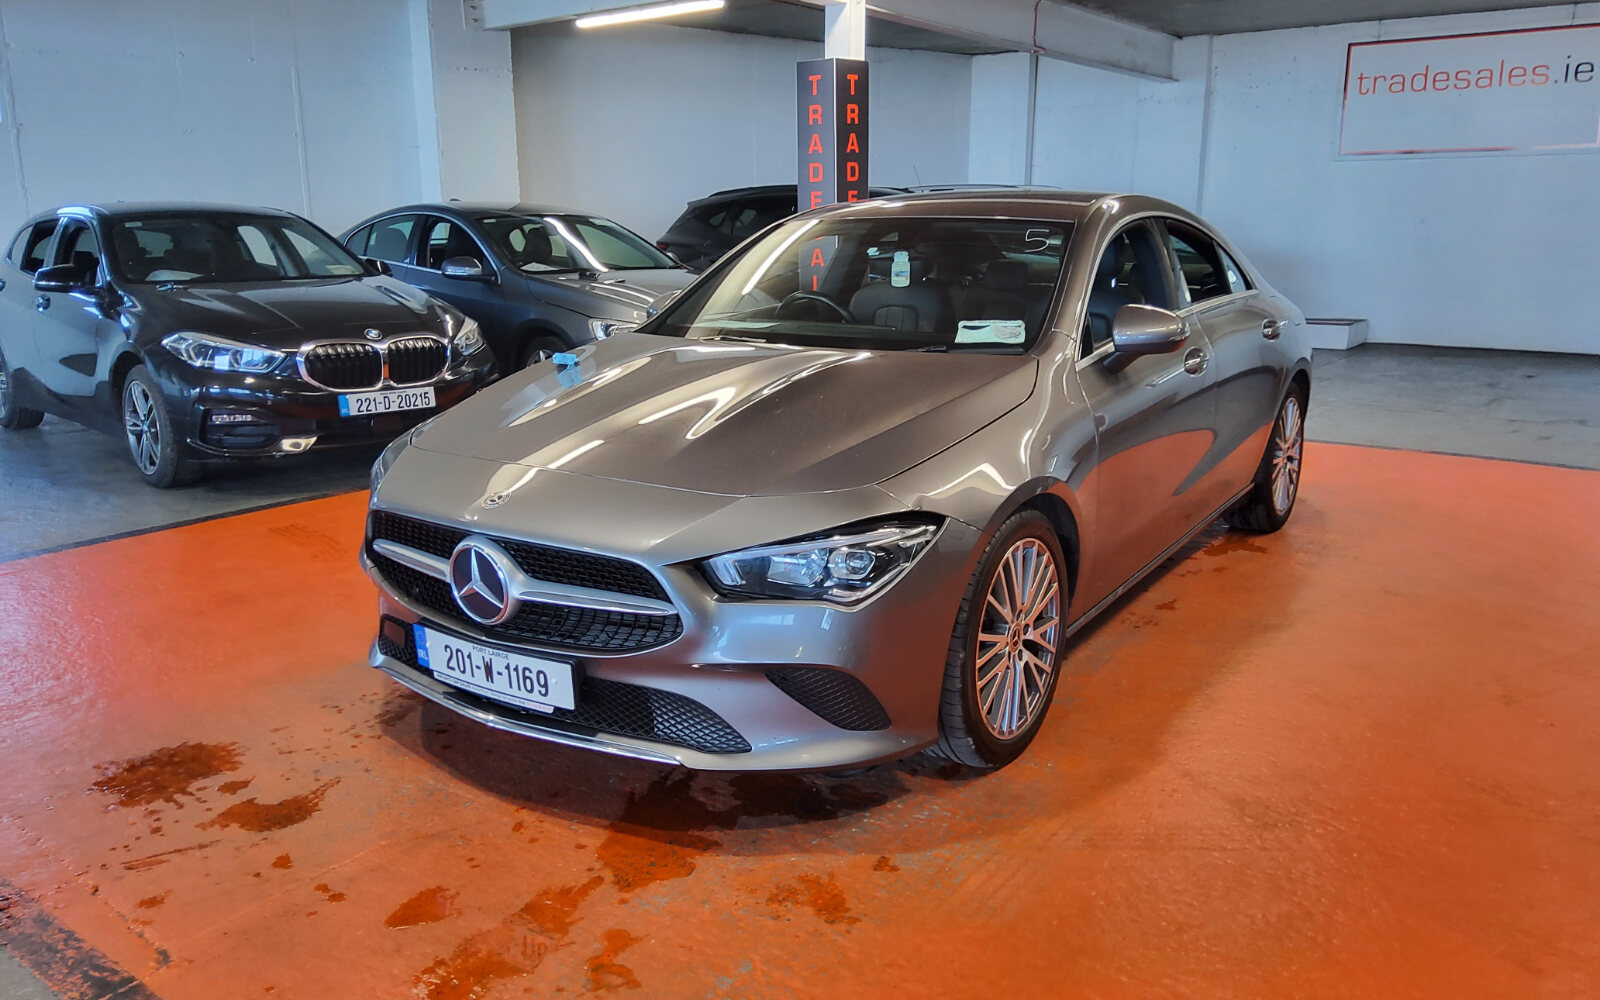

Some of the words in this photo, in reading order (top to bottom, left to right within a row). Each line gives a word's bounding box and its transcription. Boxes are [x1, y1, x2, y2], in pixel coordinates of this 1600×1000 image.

[1357, 55, 1595, 96] tradesales.ie
[1025, 228, 1050, 253] 5
[356, 391, 431, 413] 221-D-20215
[444, 644, 550, 698] 201-W-1169
